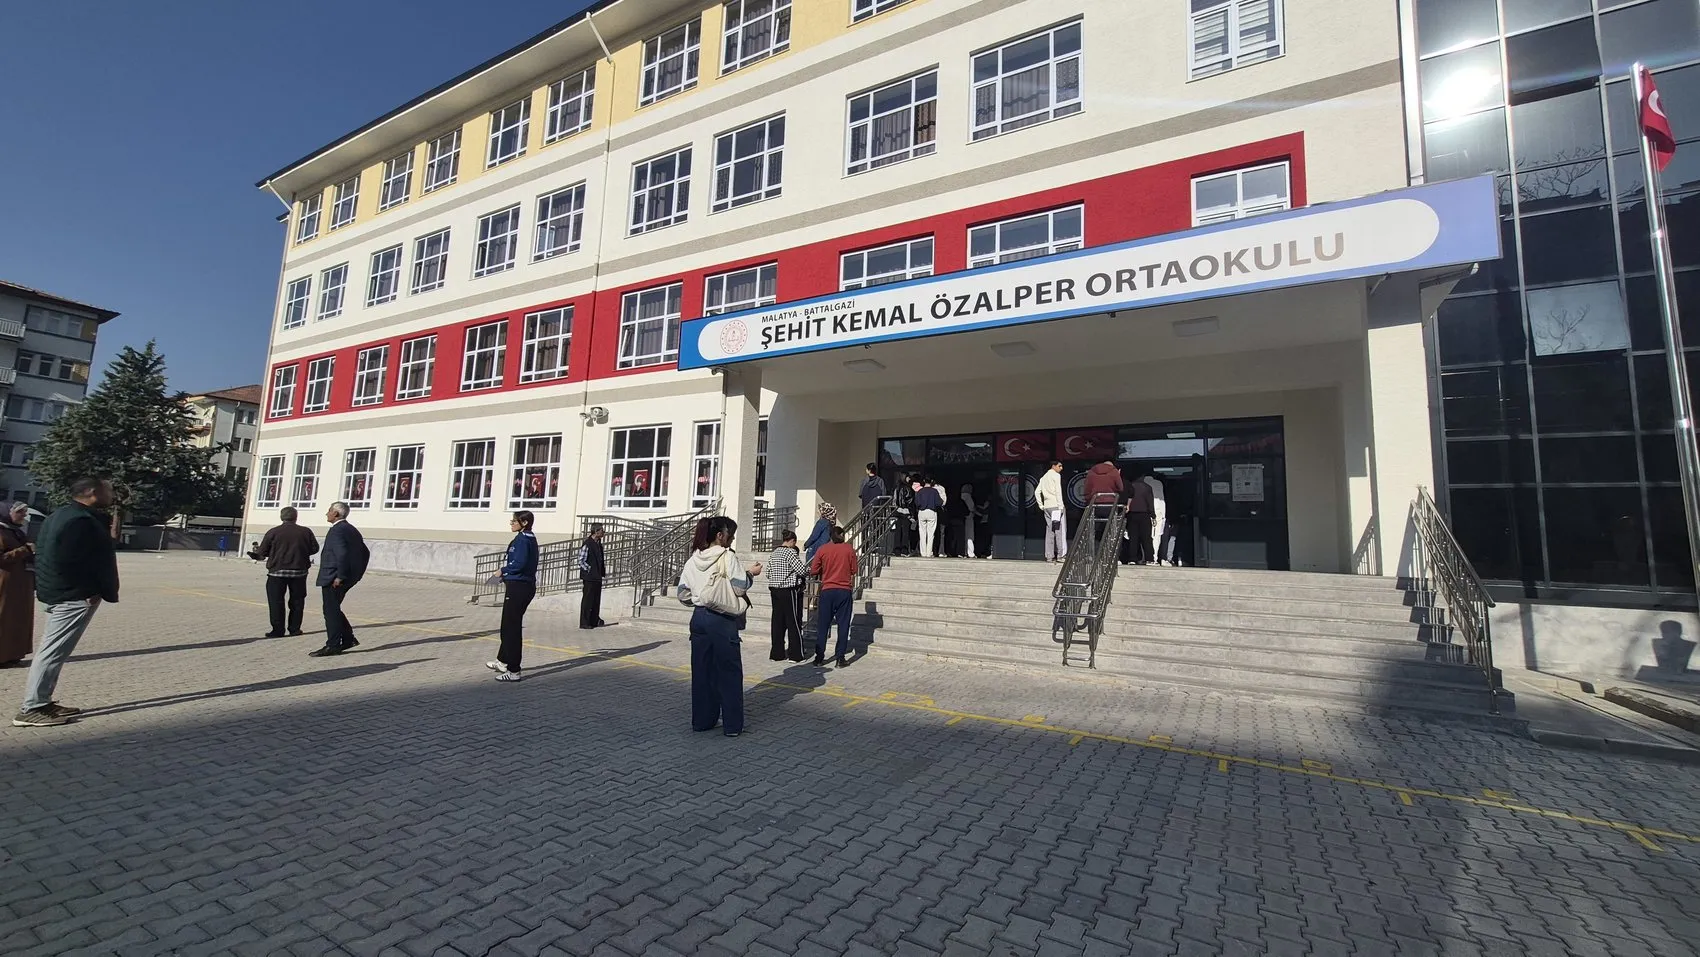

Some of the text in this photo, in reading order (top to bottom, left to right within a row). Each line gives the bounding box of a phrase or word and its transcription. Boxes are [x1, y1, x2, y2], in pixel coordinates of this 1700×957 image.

[761, 316, 826, 350] ŞEHİT
[833, 303, 923, 335] KEMAL
[930, 279, 1076, 320] ÖZALPER
[1085, 232, 1344, 297] ORTAOKULU
[761, 310, 798, 324] MALATYA
[804, 299, 855, 317] BATTALGAZİ
